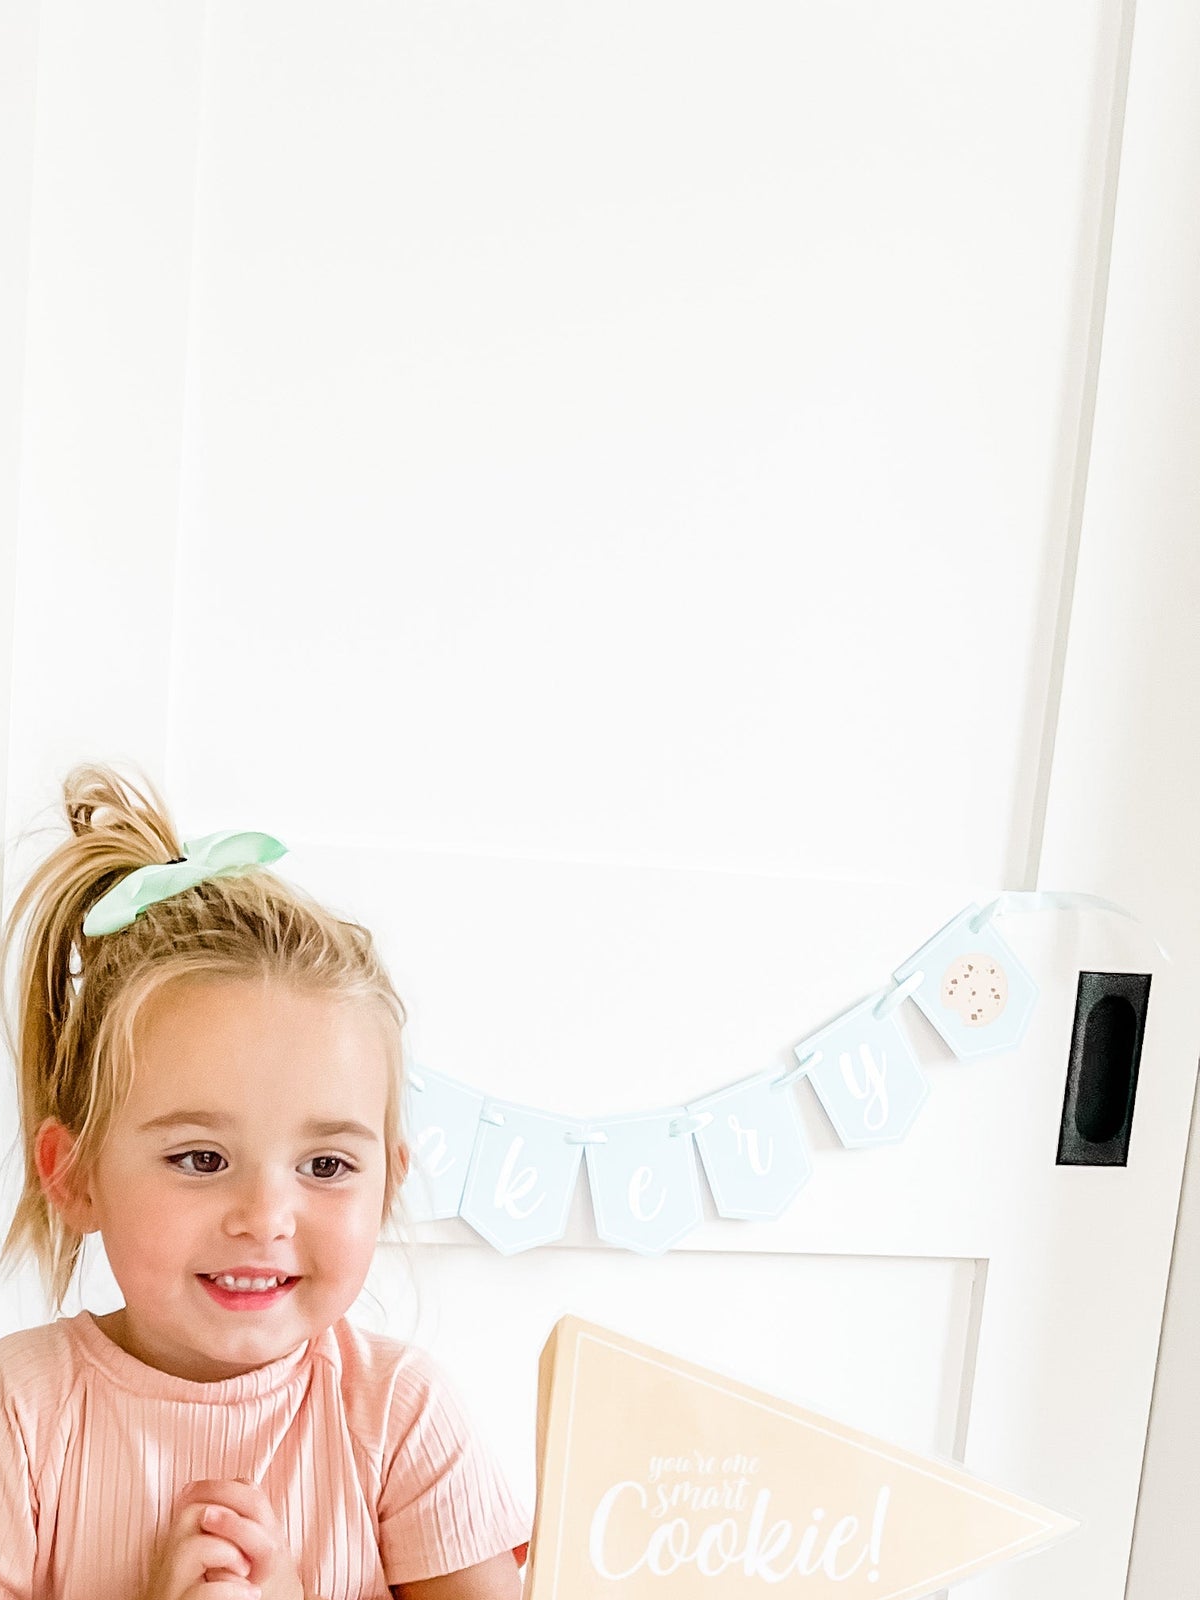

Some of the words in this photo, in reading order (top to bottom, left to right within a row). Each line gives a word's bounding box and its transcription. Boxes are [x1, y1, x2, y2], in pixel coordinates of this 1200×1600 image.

[415, 1042, 889, 1222] akery
[647, 1449, 716, 1482] you're
[720, 1453, 761, 1475] one
[650, 1477, 752, 1519] smart
[588, 1480, 892, 1585] Cookie!
